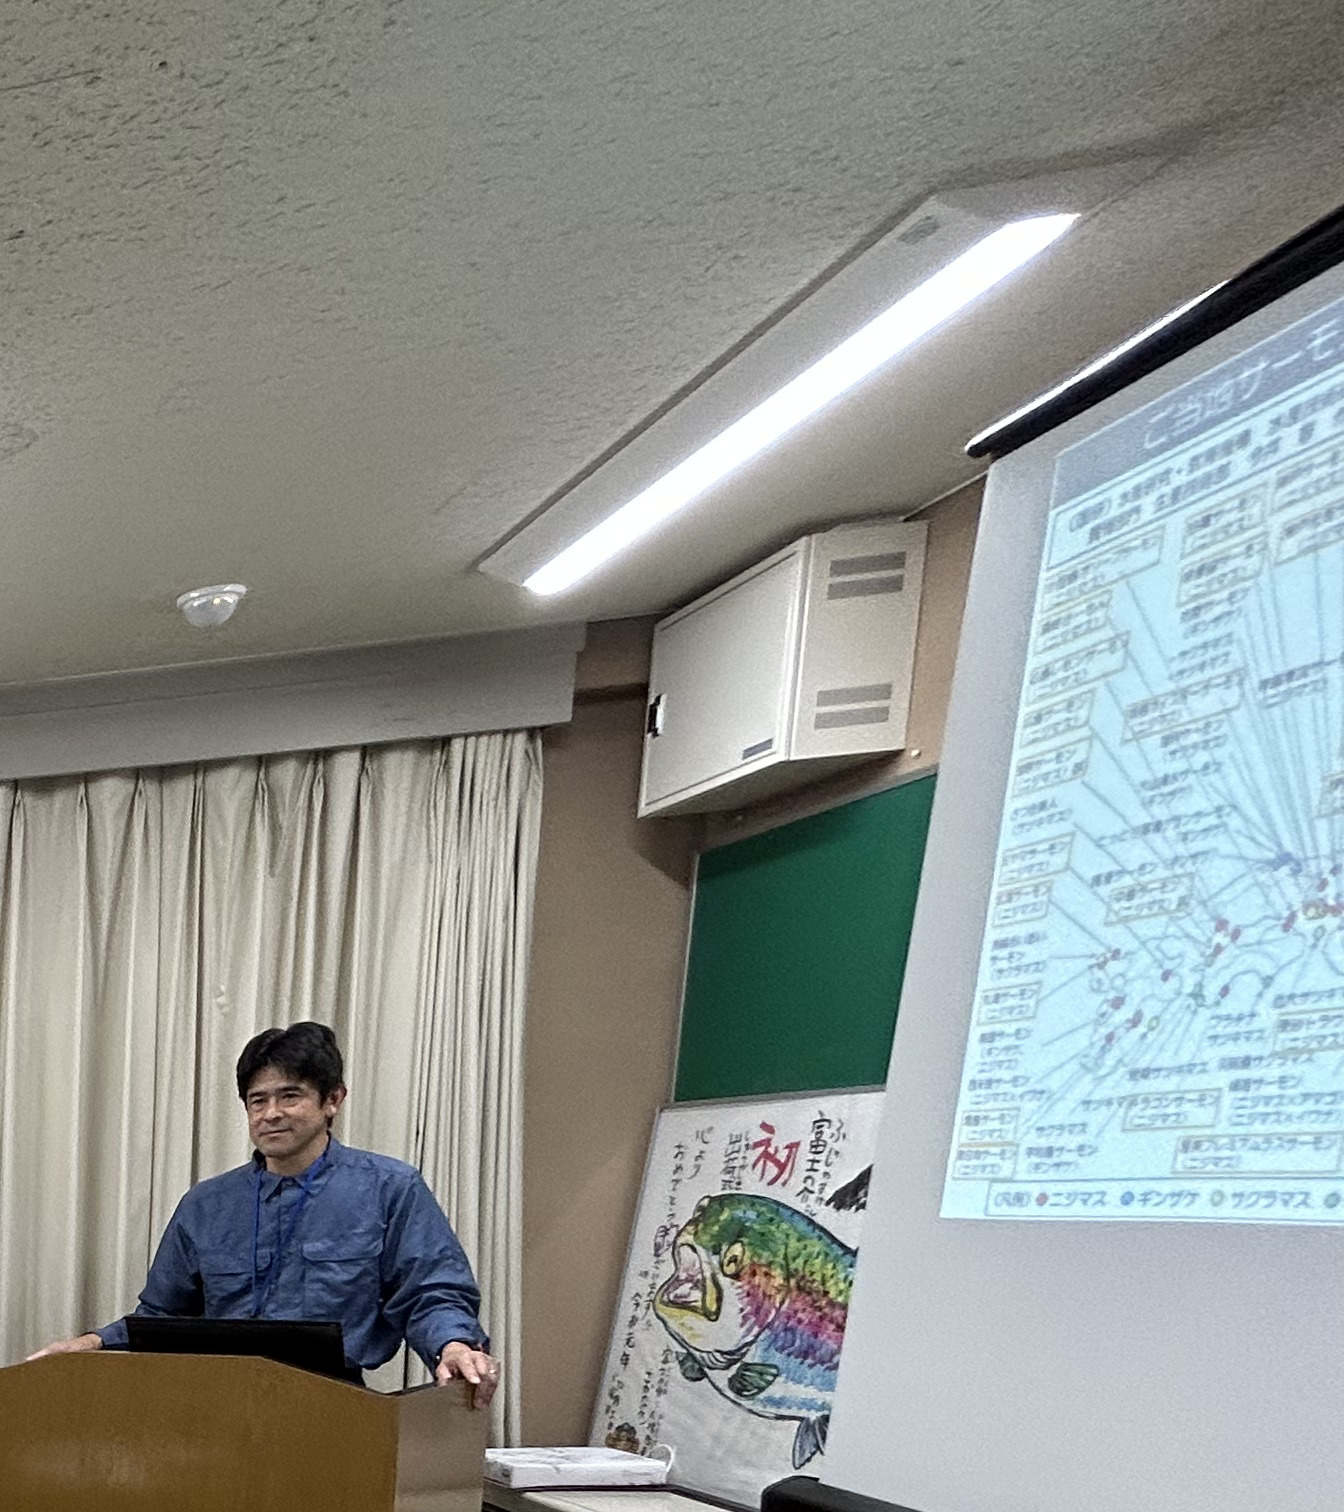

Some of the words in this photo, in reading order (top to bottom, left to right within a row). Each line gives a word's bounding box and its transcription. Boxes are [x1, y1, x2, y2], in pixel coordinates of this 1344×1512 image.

[1143, 317, 1344, 450] ご当地サーモ
[752, 1120, 801, 1187] 初
[1049, 1191, 1107, 1207] ニジマス
[1138, 1189, 1199, 1207] ギンザケ
[1231, 1190, 1312, 1209] サクラマス
